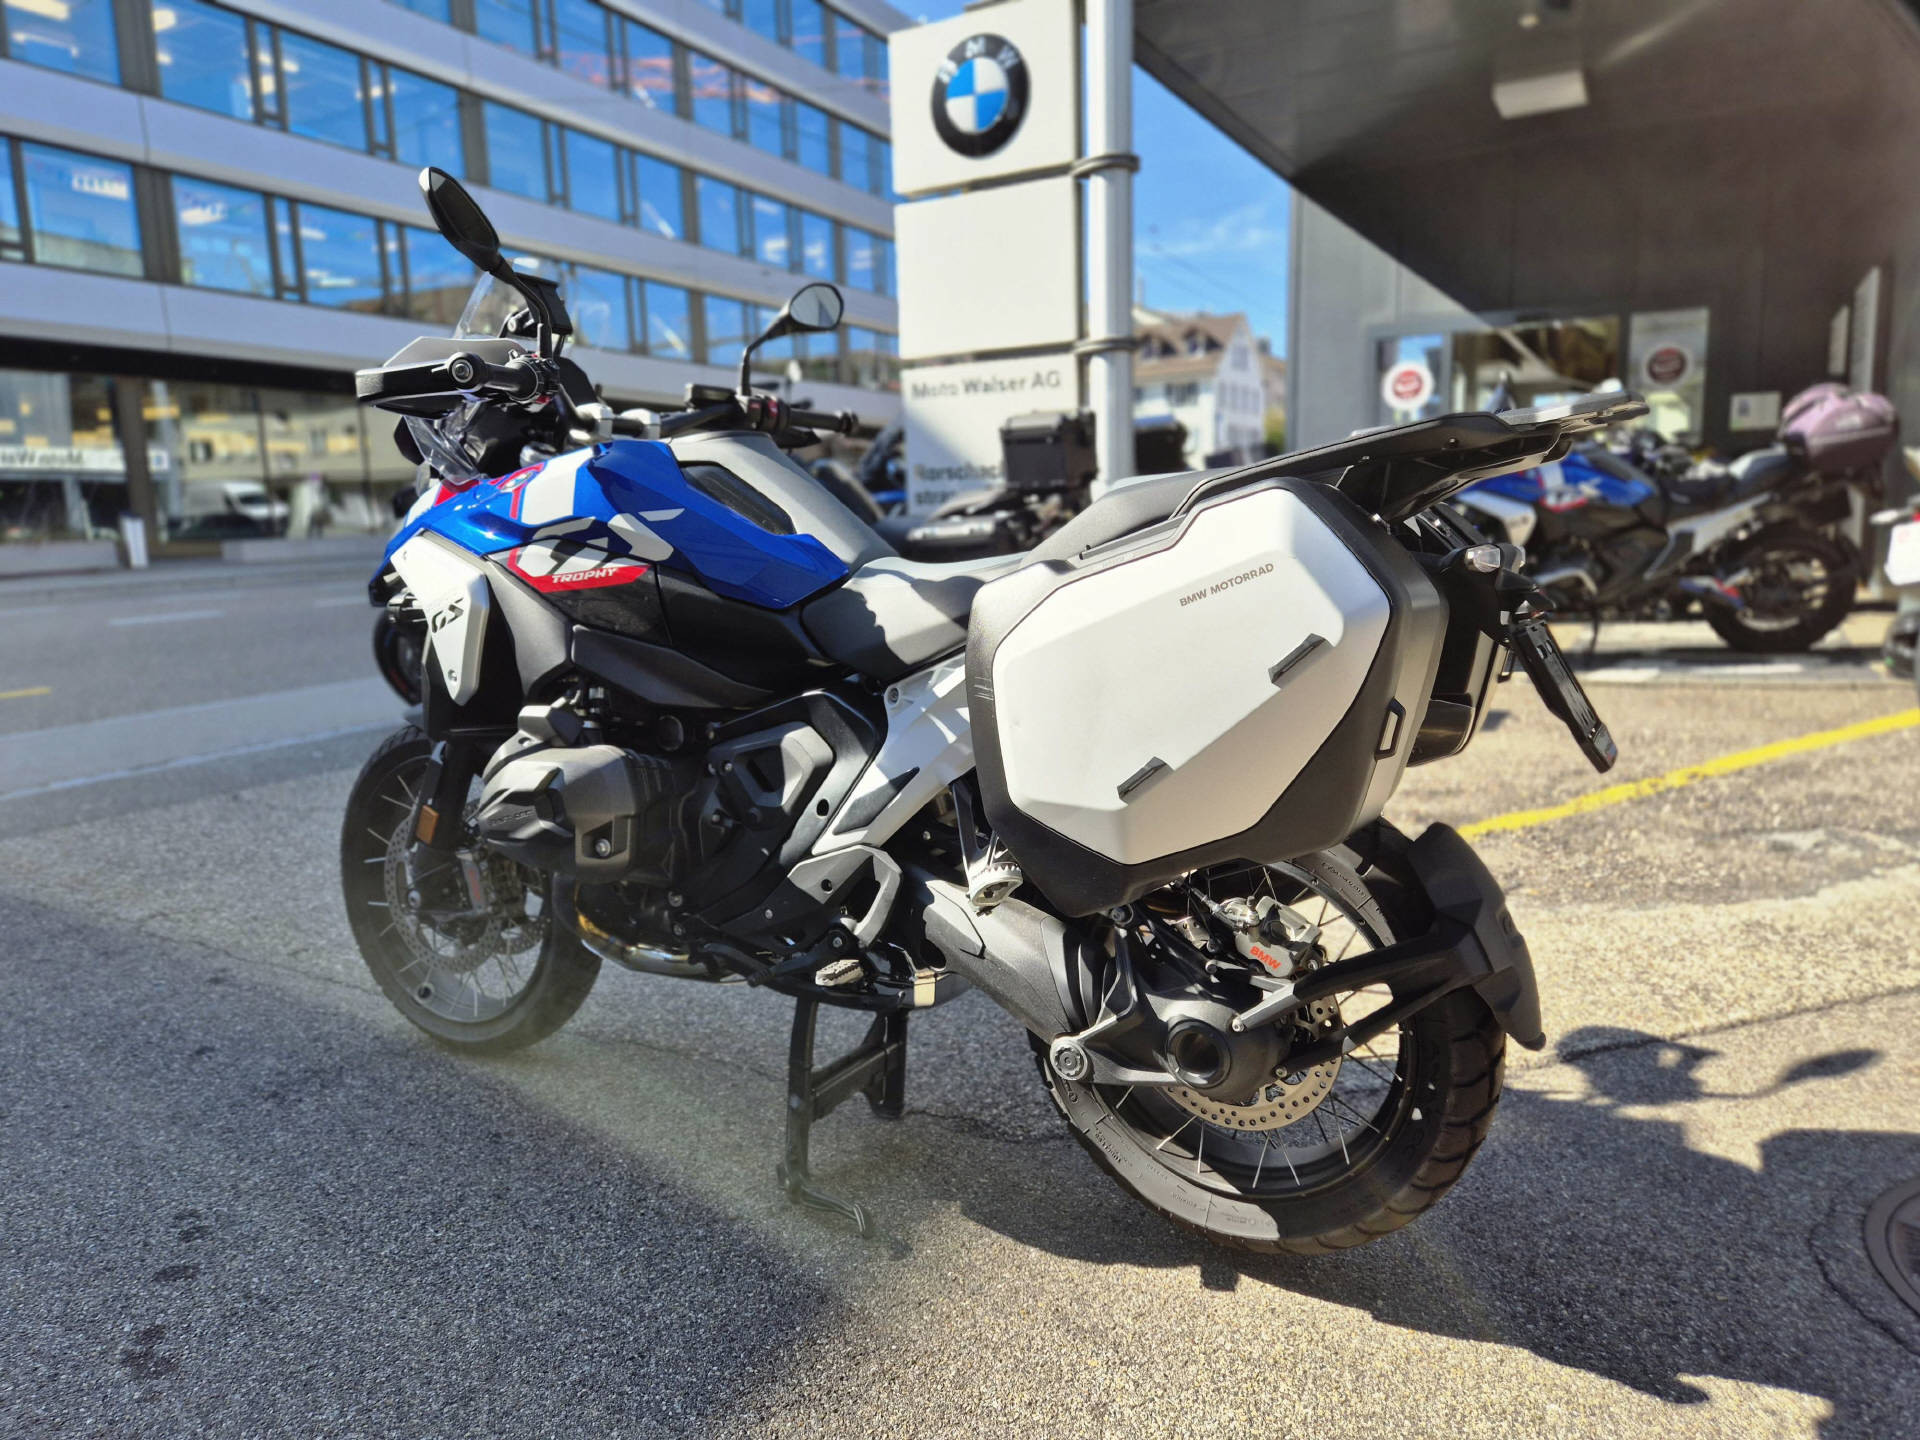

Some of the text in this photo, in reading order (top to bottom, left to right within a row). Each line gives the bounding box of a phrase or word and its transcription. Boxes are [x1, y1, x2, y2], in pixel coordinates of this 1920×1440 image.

[938, 36, 1020, 84] BMW
[1031, 370, 1061, 389] AG
[551, 567, 618, 584] TROPHY
[1179, 563, 1275, 607] BMW MOTORRAD
[1249, 945, 1283, 970] BMW
